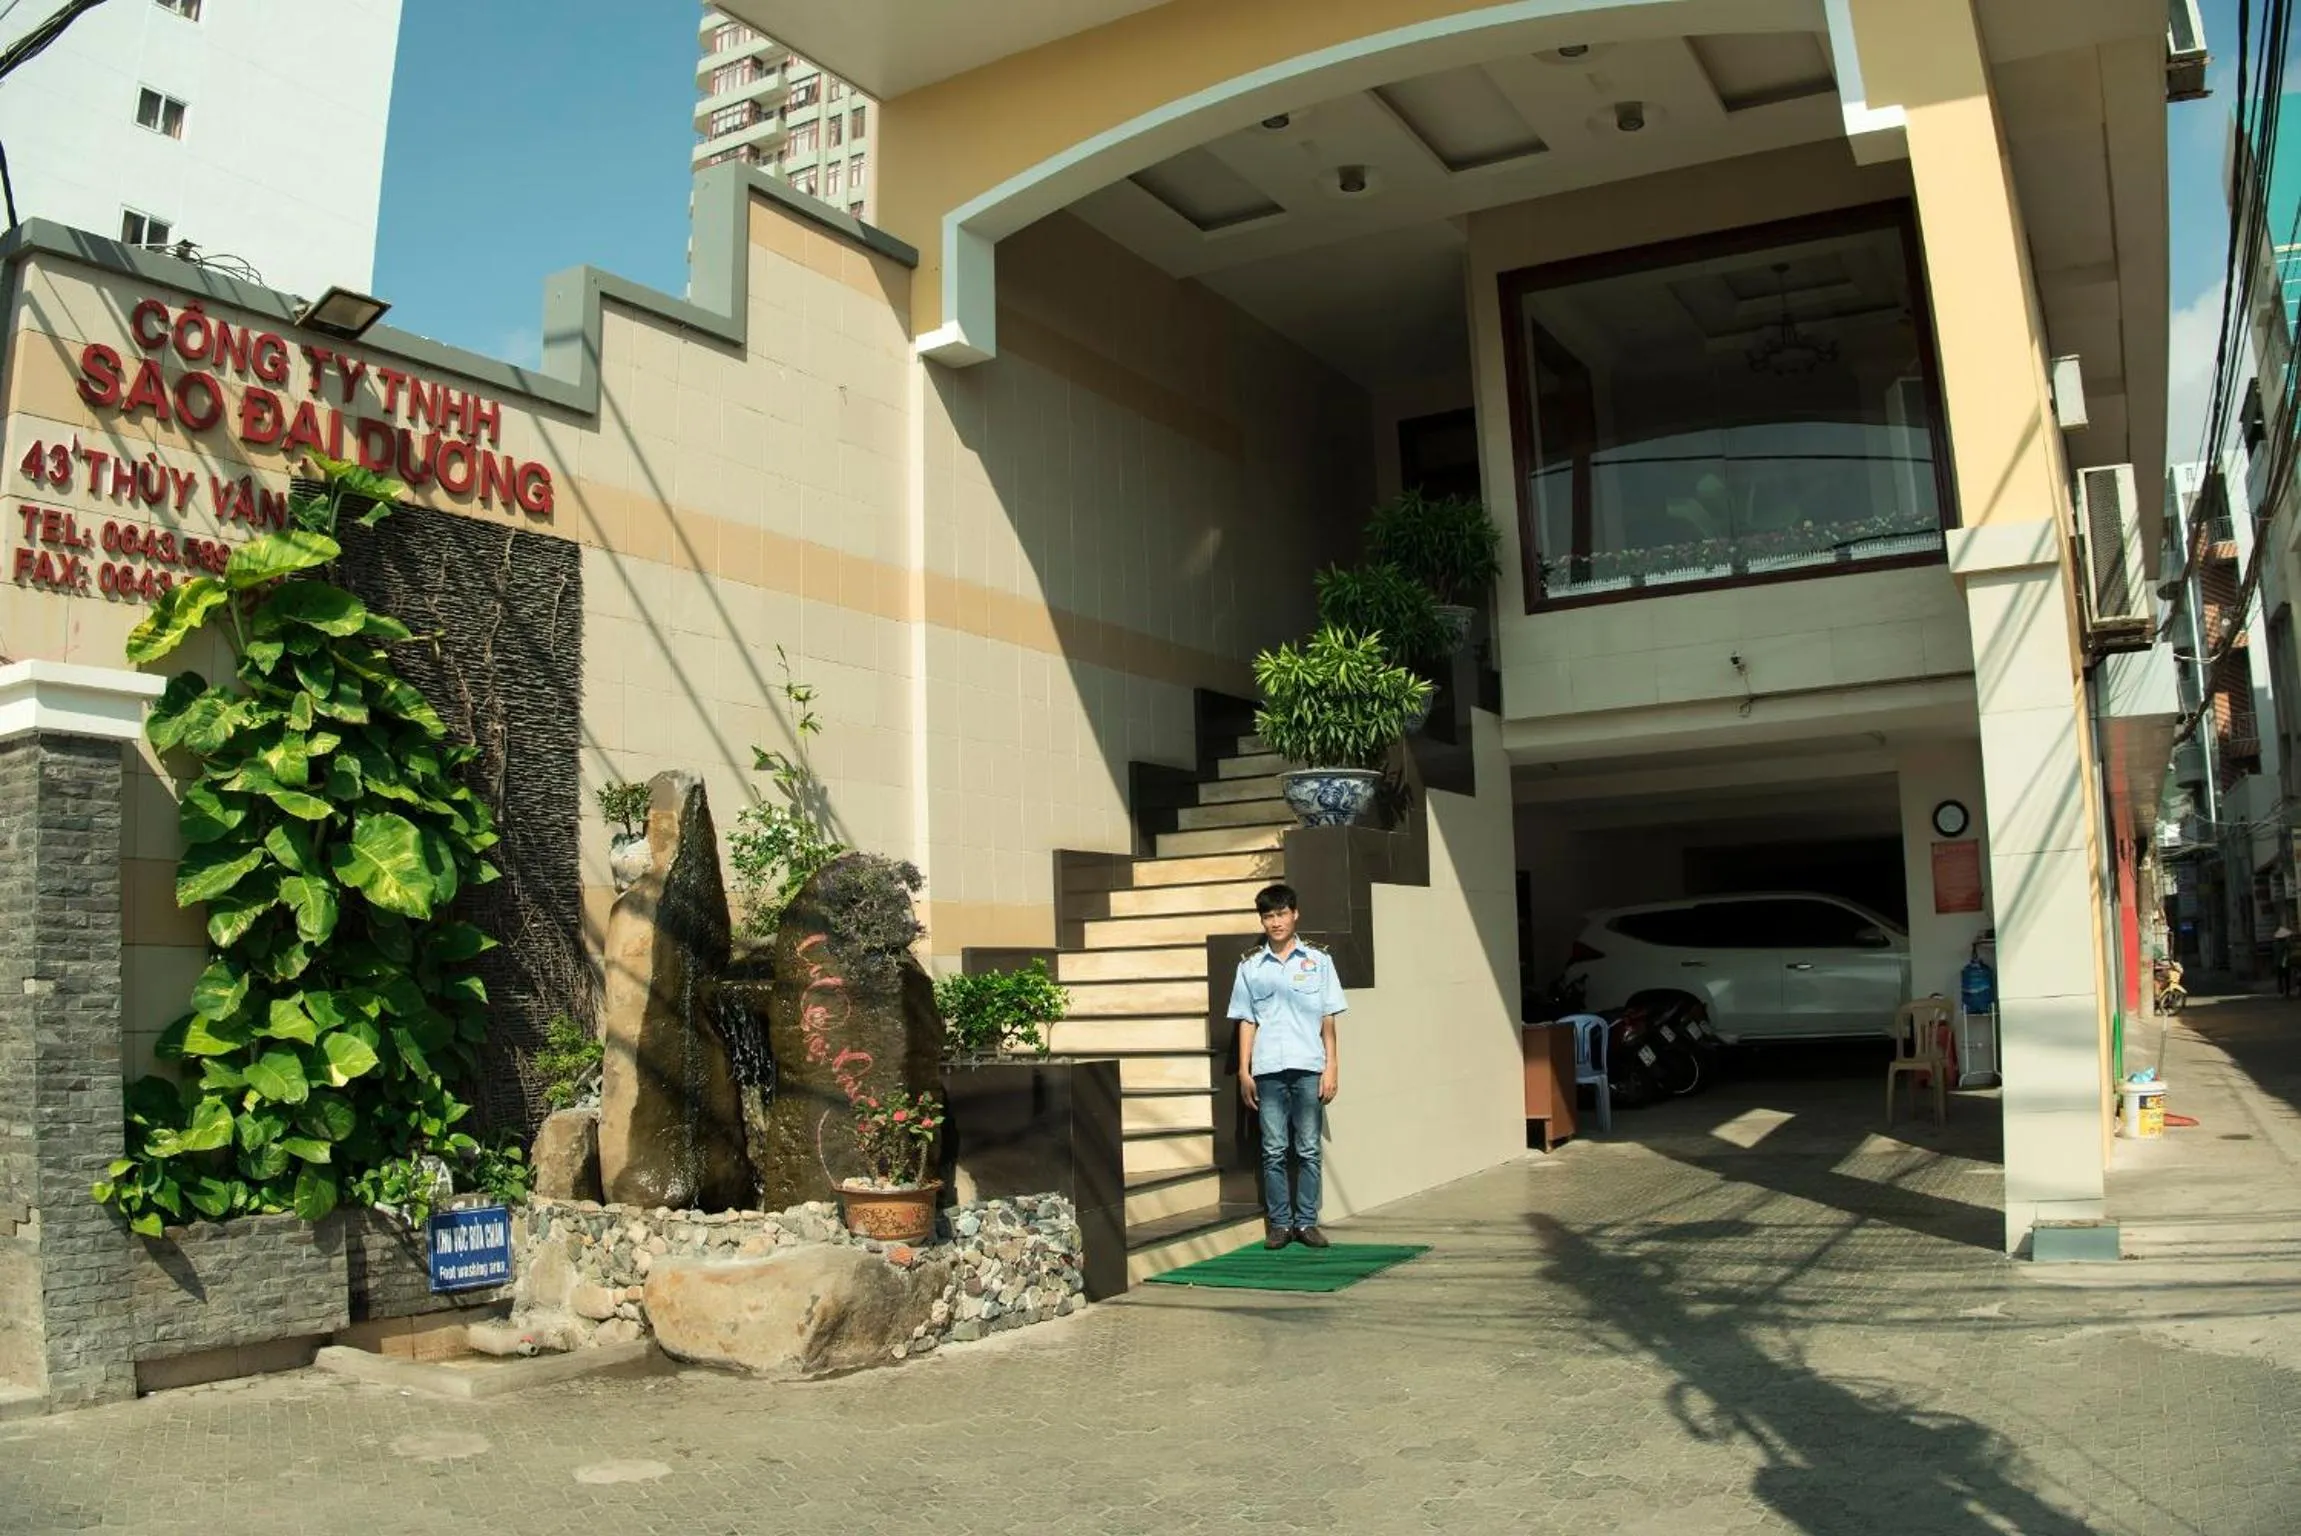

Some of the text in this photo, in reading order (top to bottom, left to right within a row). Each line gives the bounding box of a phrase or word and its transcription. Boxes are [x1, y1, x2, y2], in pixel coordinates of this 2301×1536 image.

[131, 298, 501, 443] CÔNG TY TNHH
[77, 343, 223, 431] SAO
[358, 417, 554, 513] DƯƠNG
[19, 504, 94, 549] TEL:
[14, 548, 89, 589] FAX:
[439, 1265, 456, 1280] Foot
[457, 1261, 488, 1277] washing
